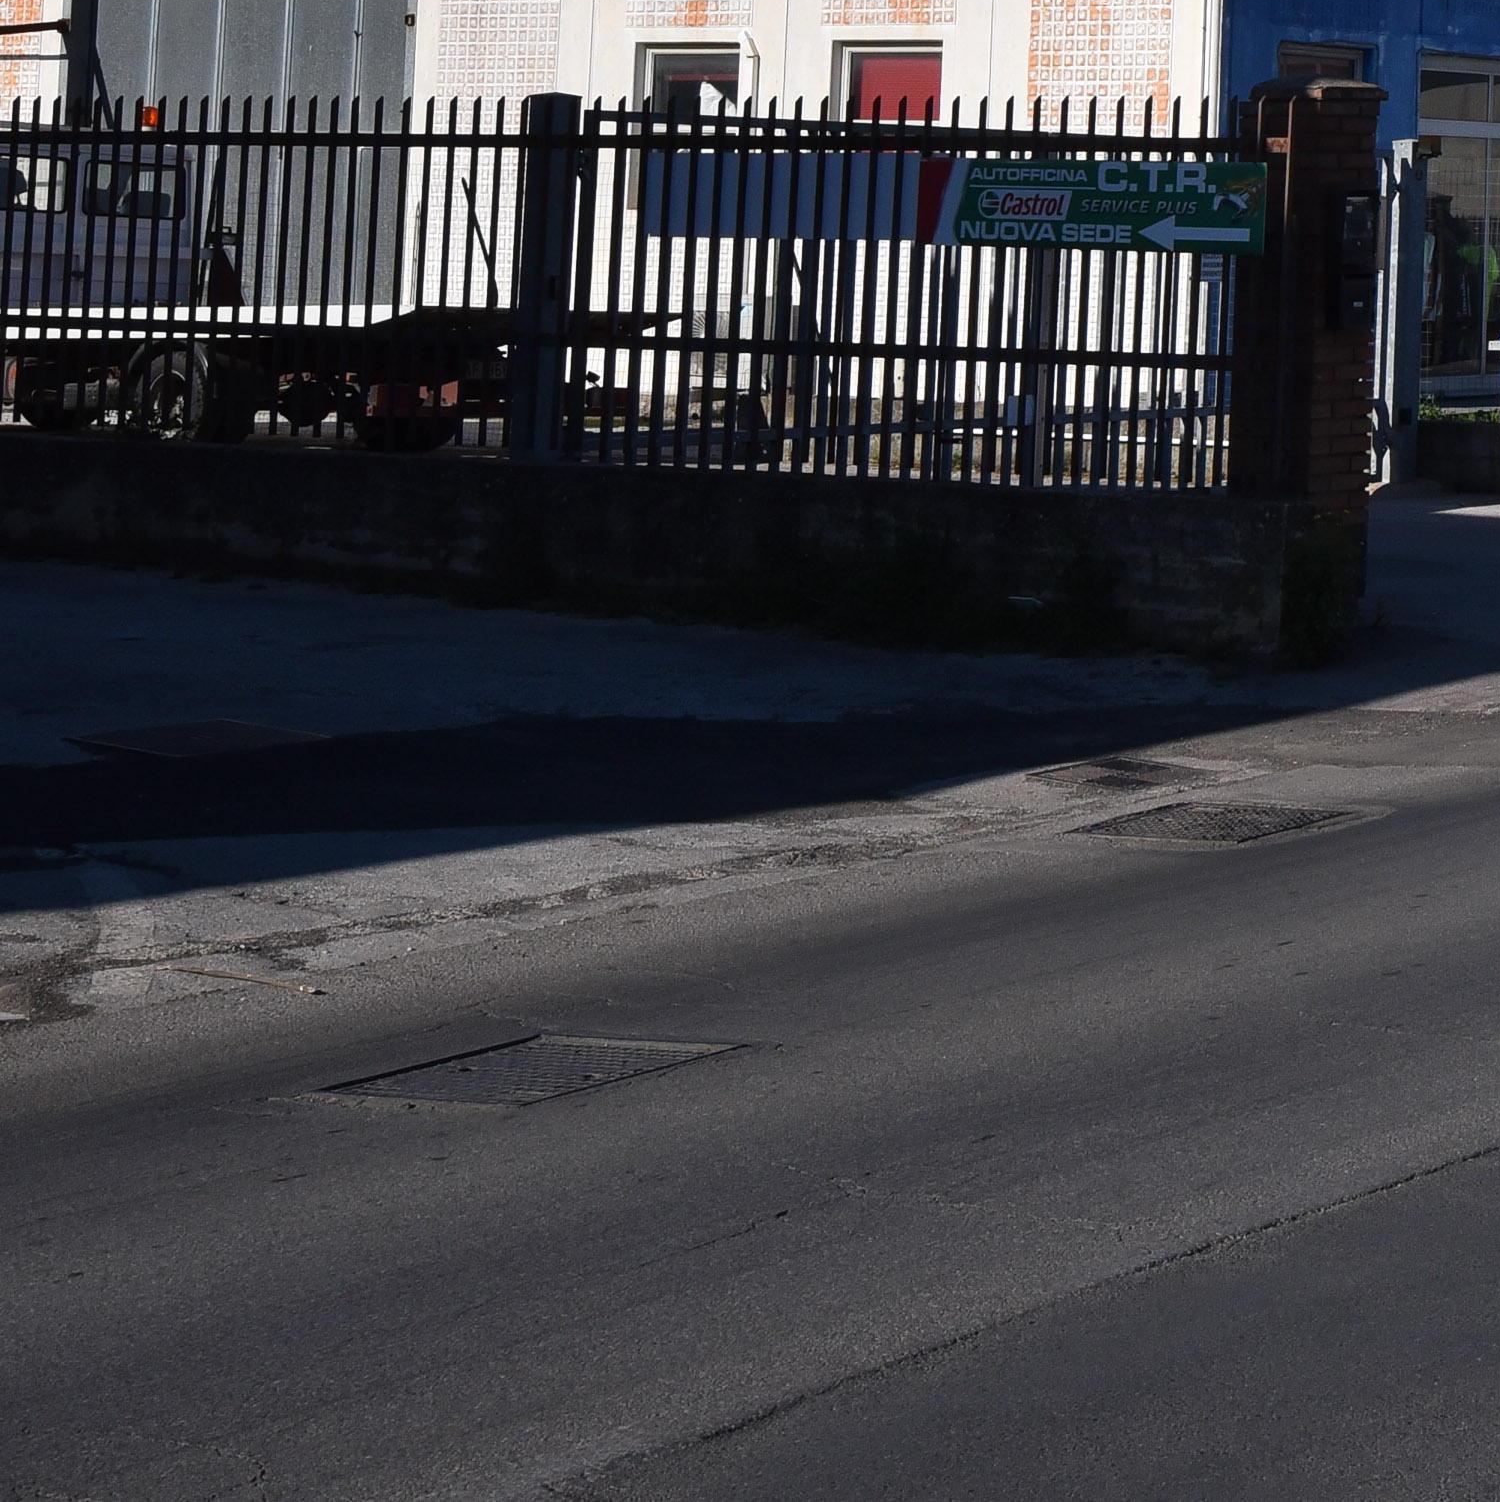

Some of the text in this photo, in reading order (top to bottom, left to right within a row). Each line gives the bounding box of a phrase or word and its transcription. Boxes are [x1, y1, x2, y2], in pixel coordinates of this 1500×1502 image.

[969, 161, 1217, 194] AUTOFFICINA C.T.R.
[1000, 192, 1197, 217] Castrol SERVICE PLUS
[959, 221, 1132, 244] NUOVA SEDE
